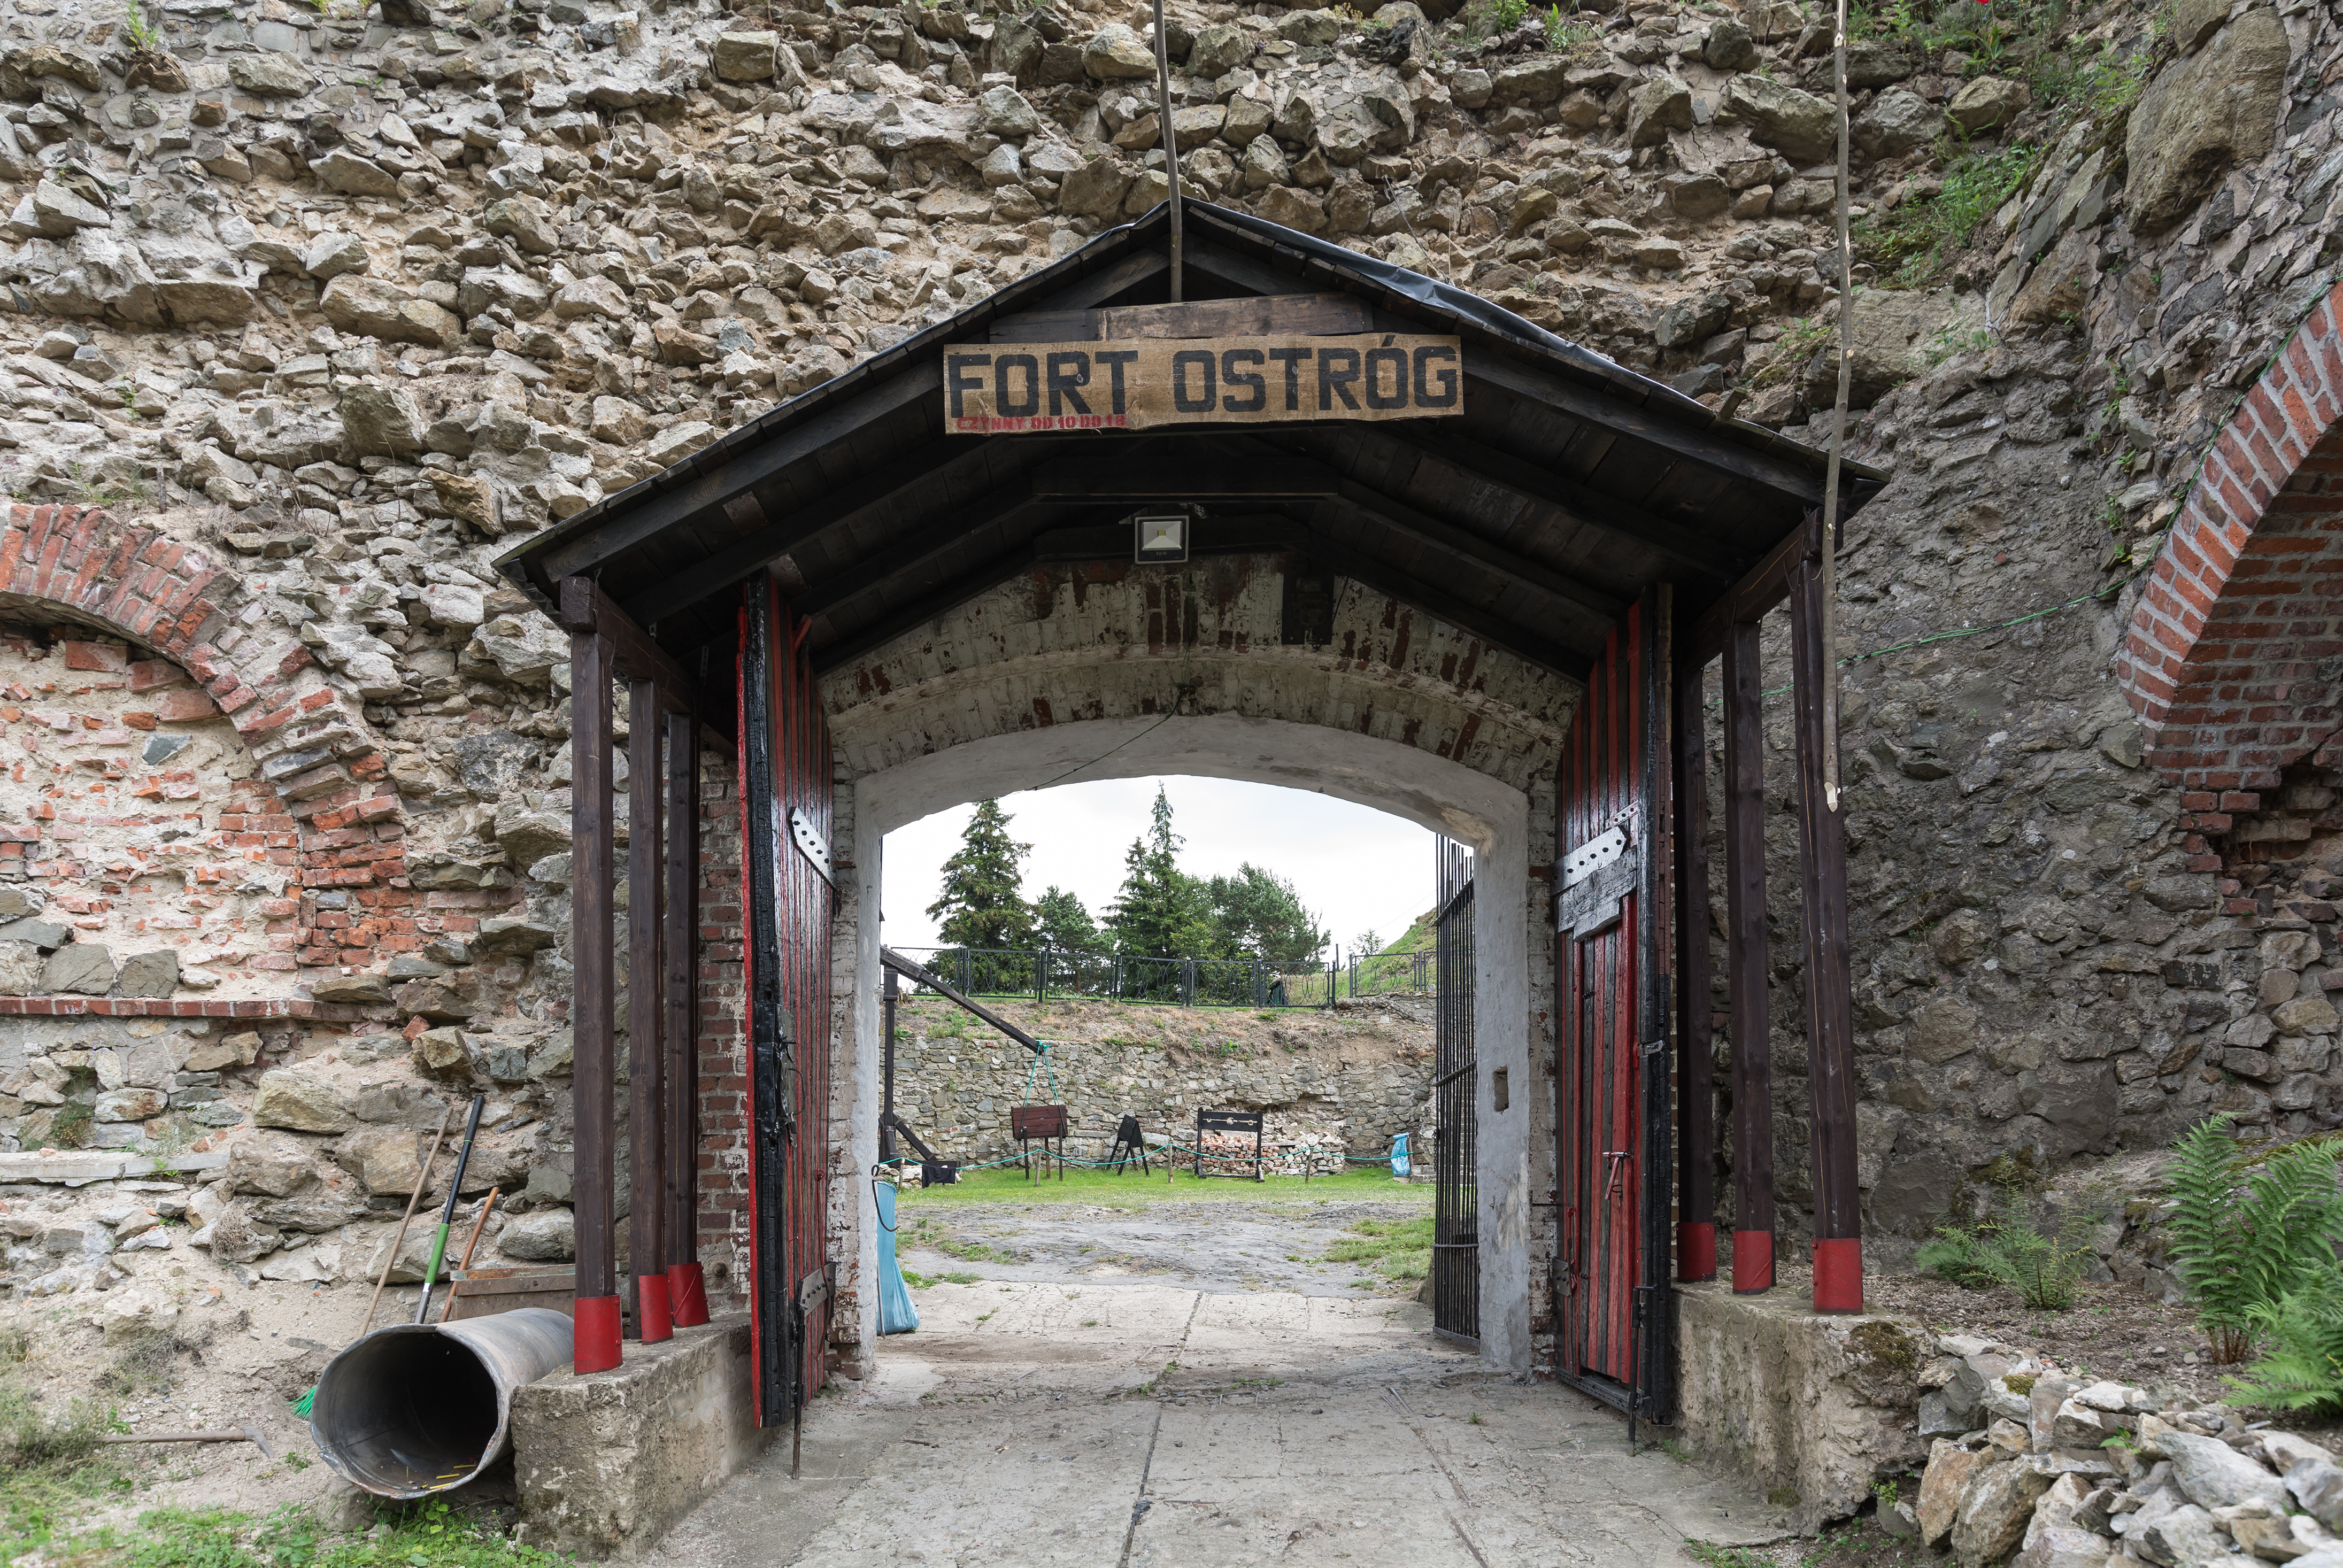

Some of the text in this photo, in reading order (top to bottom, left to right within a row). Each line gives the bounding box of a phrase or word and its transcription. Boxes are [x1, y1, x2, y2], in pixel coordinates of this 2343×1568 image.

[948, 335, 1457, 418] FORT OSTRÓG
[957, 414, 1126, 430] CZYNNY OD 10 DO 18
